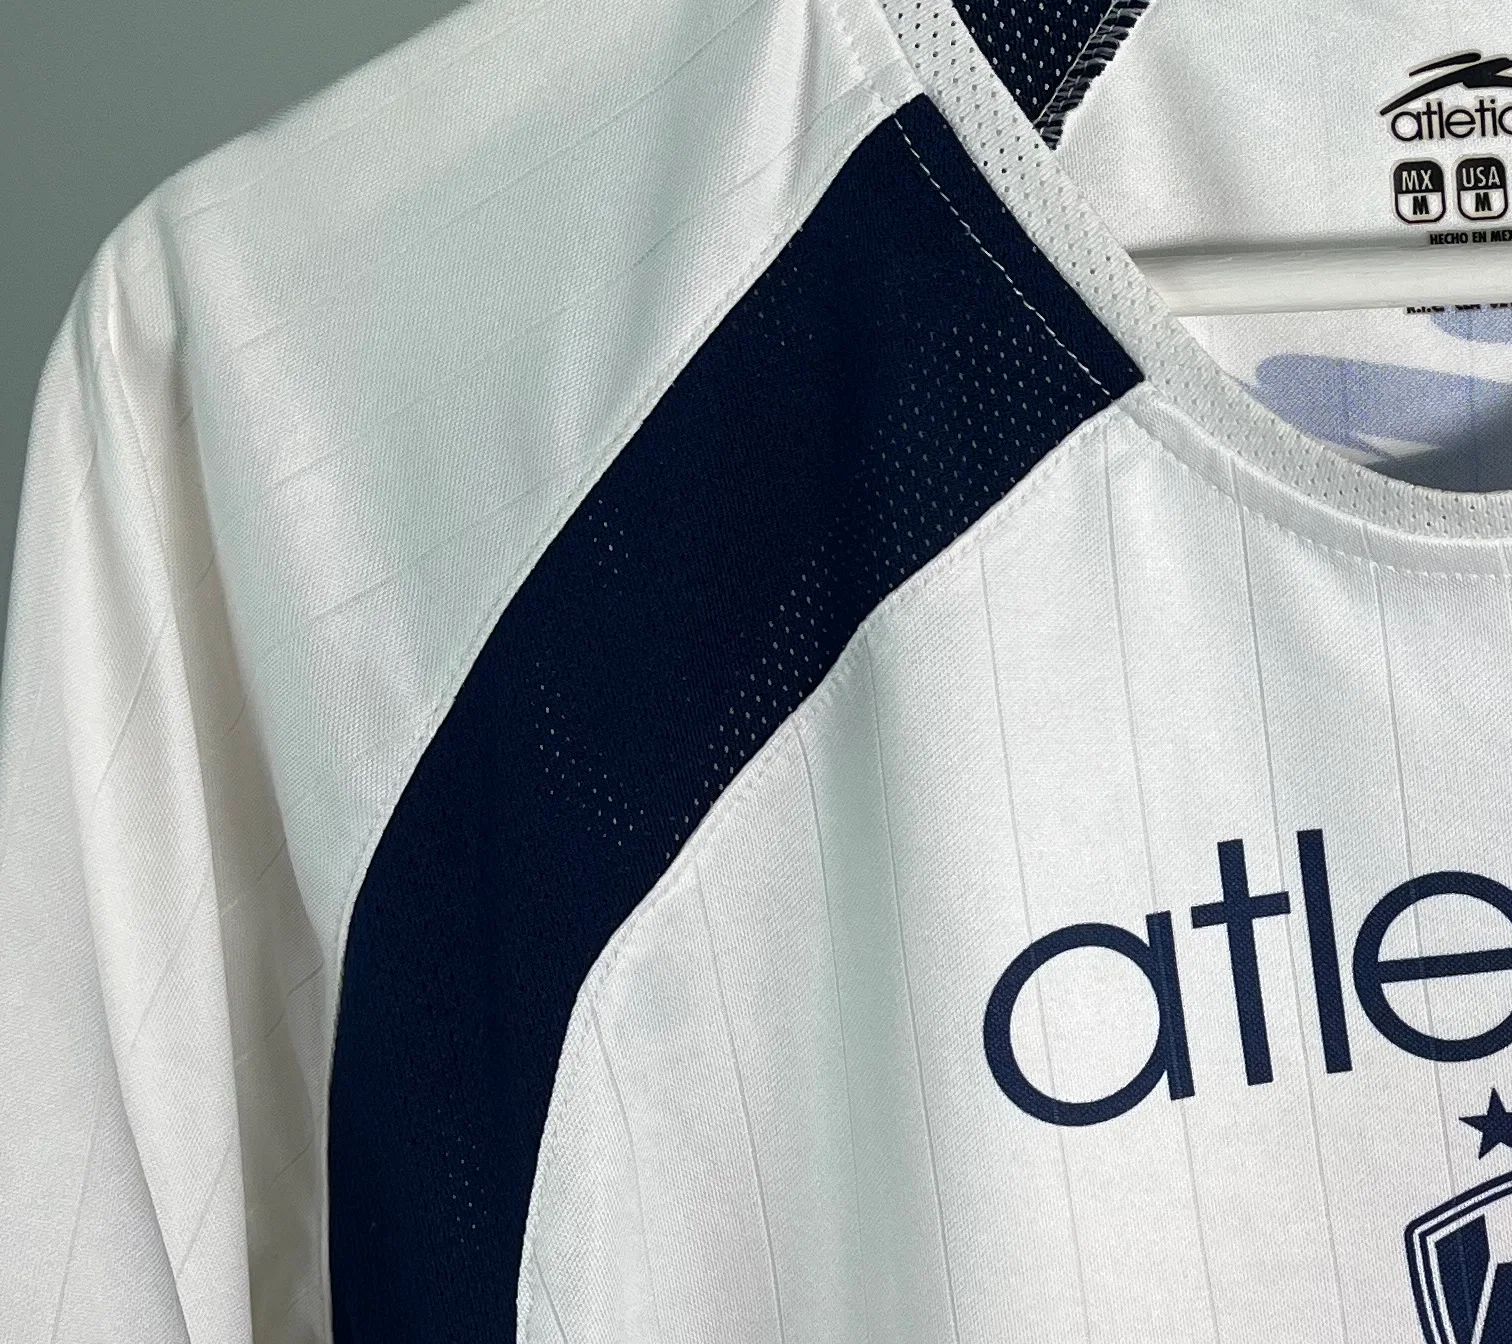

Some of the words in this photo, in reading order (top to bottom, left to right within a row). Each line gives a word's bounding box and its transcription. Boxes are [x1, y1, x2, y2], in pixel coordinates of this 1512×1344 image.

[1401, 169, 1434, 191] MX
[1462, 166, 1500, 187] USA
[1412, 195, 1429, 215] M
[1475, 191, 1491, 212] M
[1430, 232, 1468, 245] HECHO
[1472, 231, 1487, 243] EN
